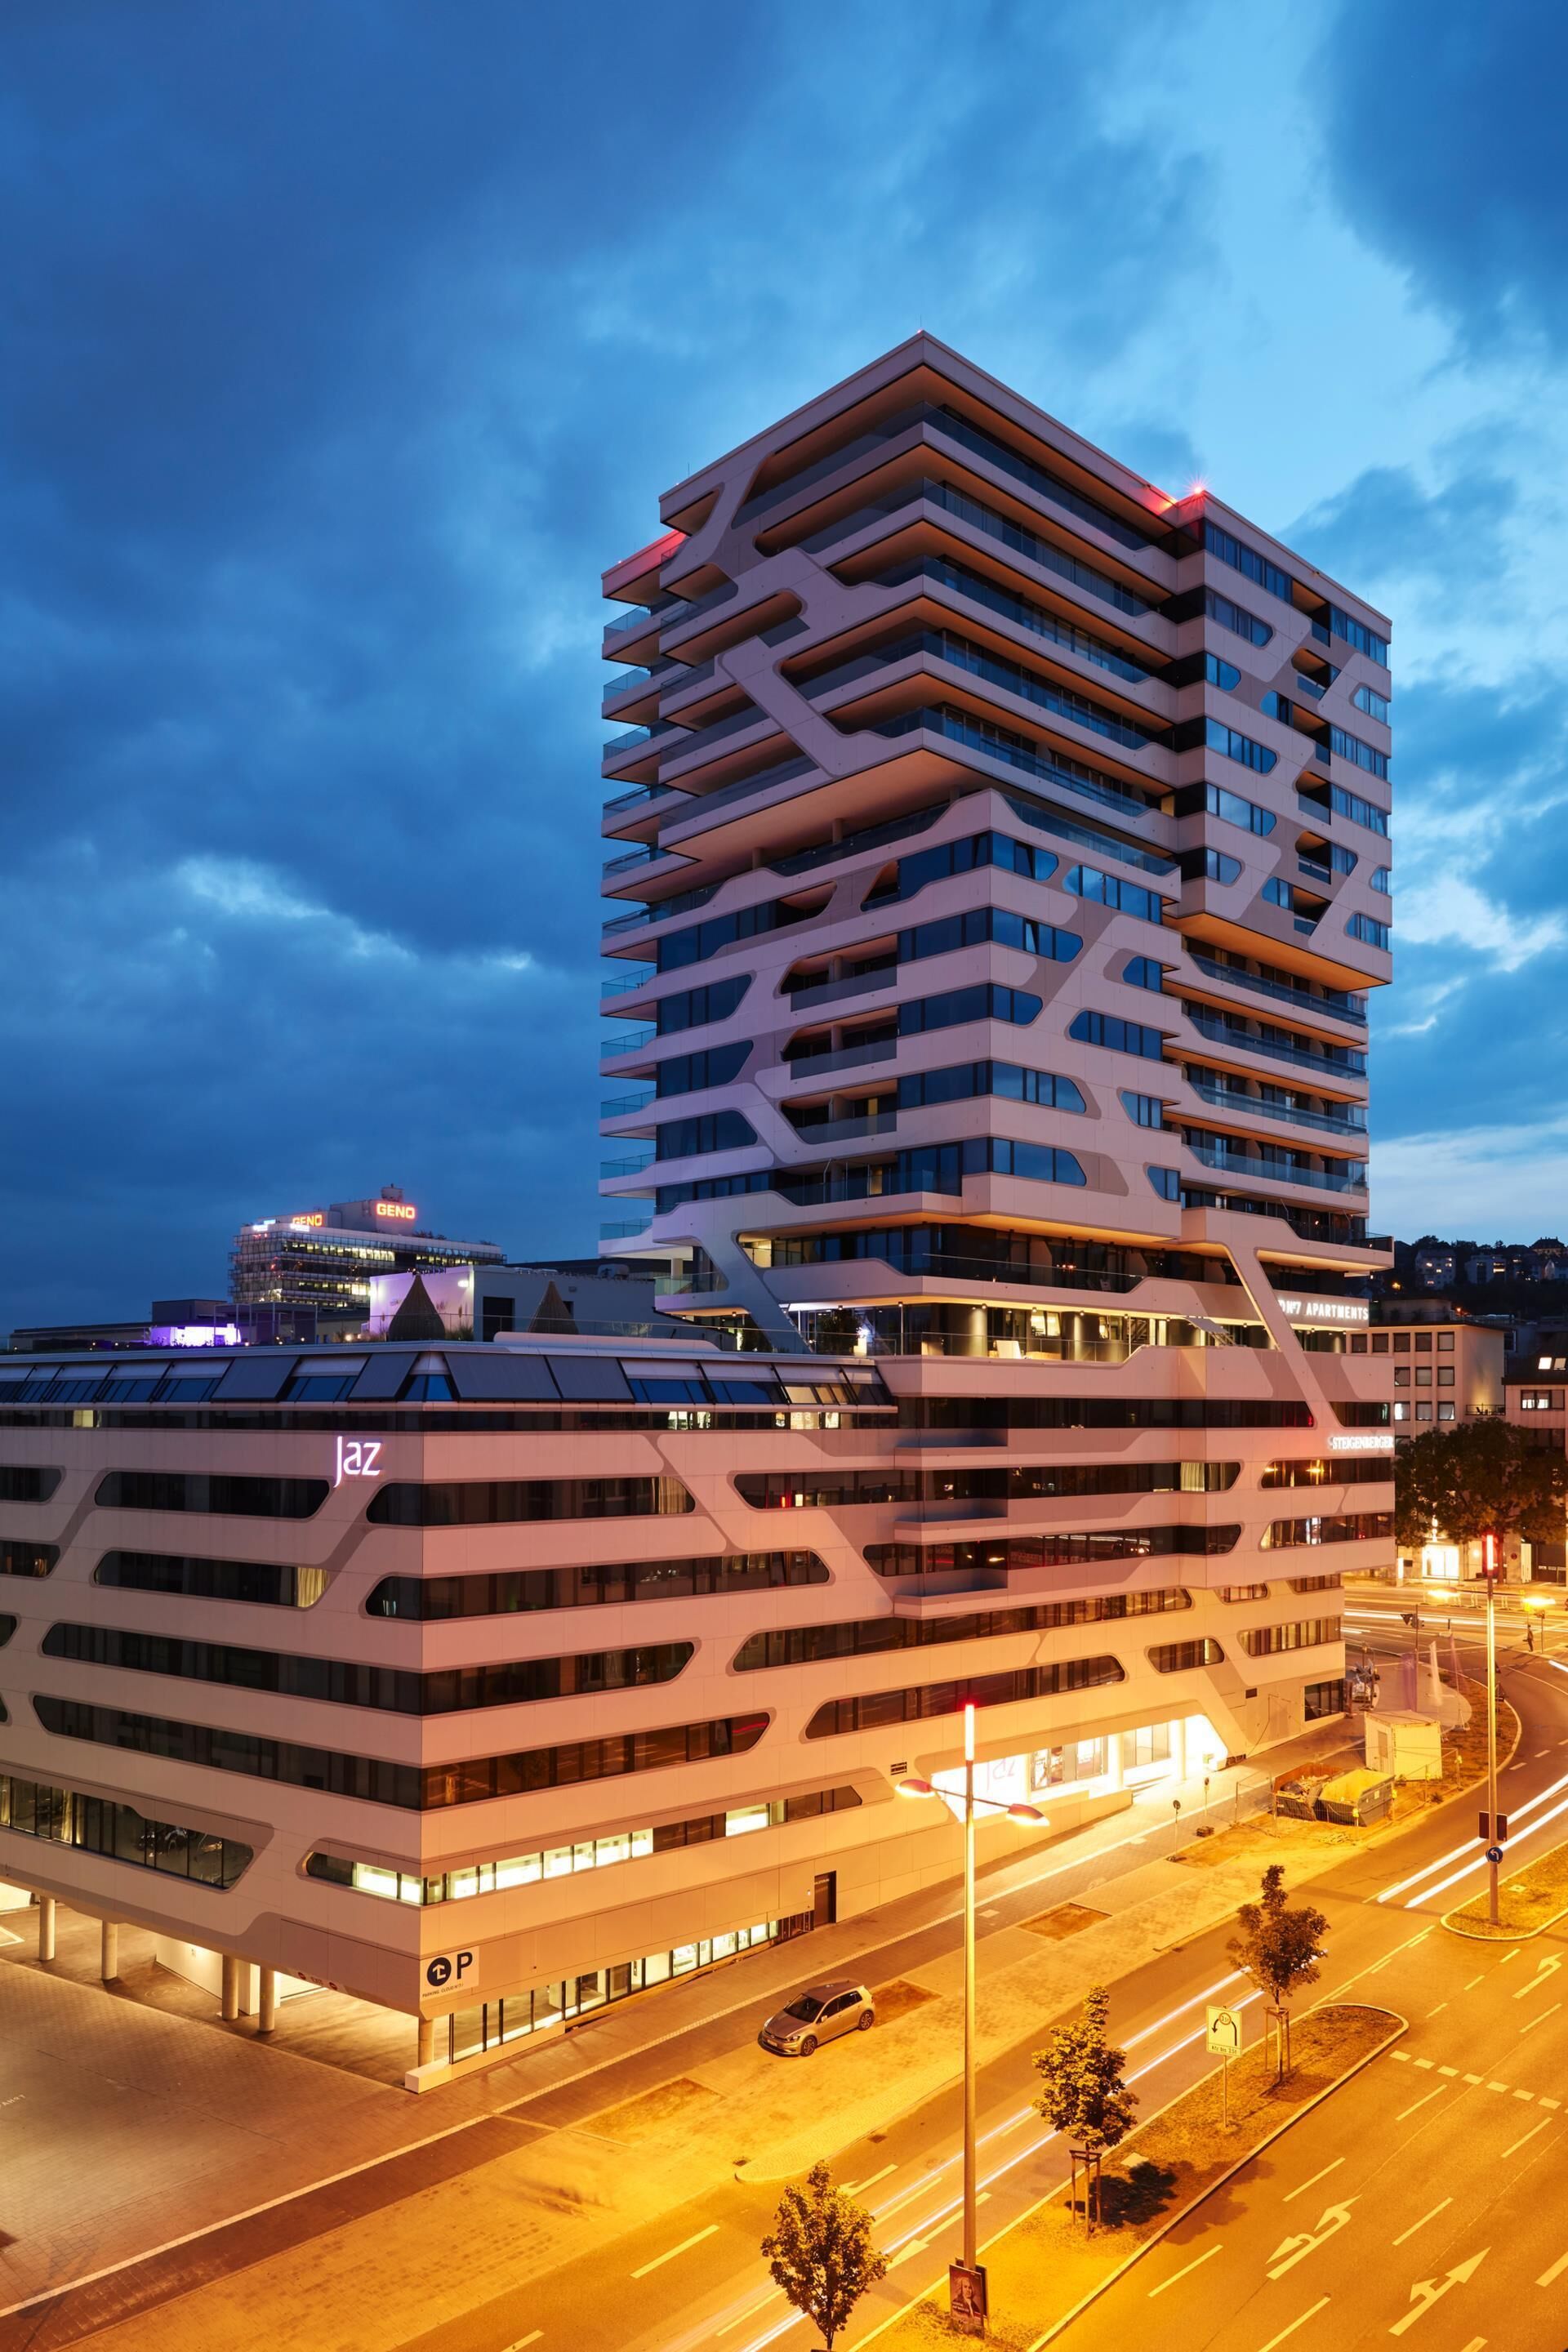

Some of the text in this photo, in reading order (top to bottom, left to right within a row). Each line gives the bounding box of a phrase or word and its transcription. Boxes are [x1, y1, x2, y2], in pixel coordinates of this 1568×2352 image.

[376, 1203, 416, 1219] GENO
[292, 1214, 323, 1227] GENO
[1306, 1302, 1369, 1321] APARTMENTS
[1332, 1435, 1394, 1450] STEIGENBERGER
[457, 1951, 473, 1980] P
